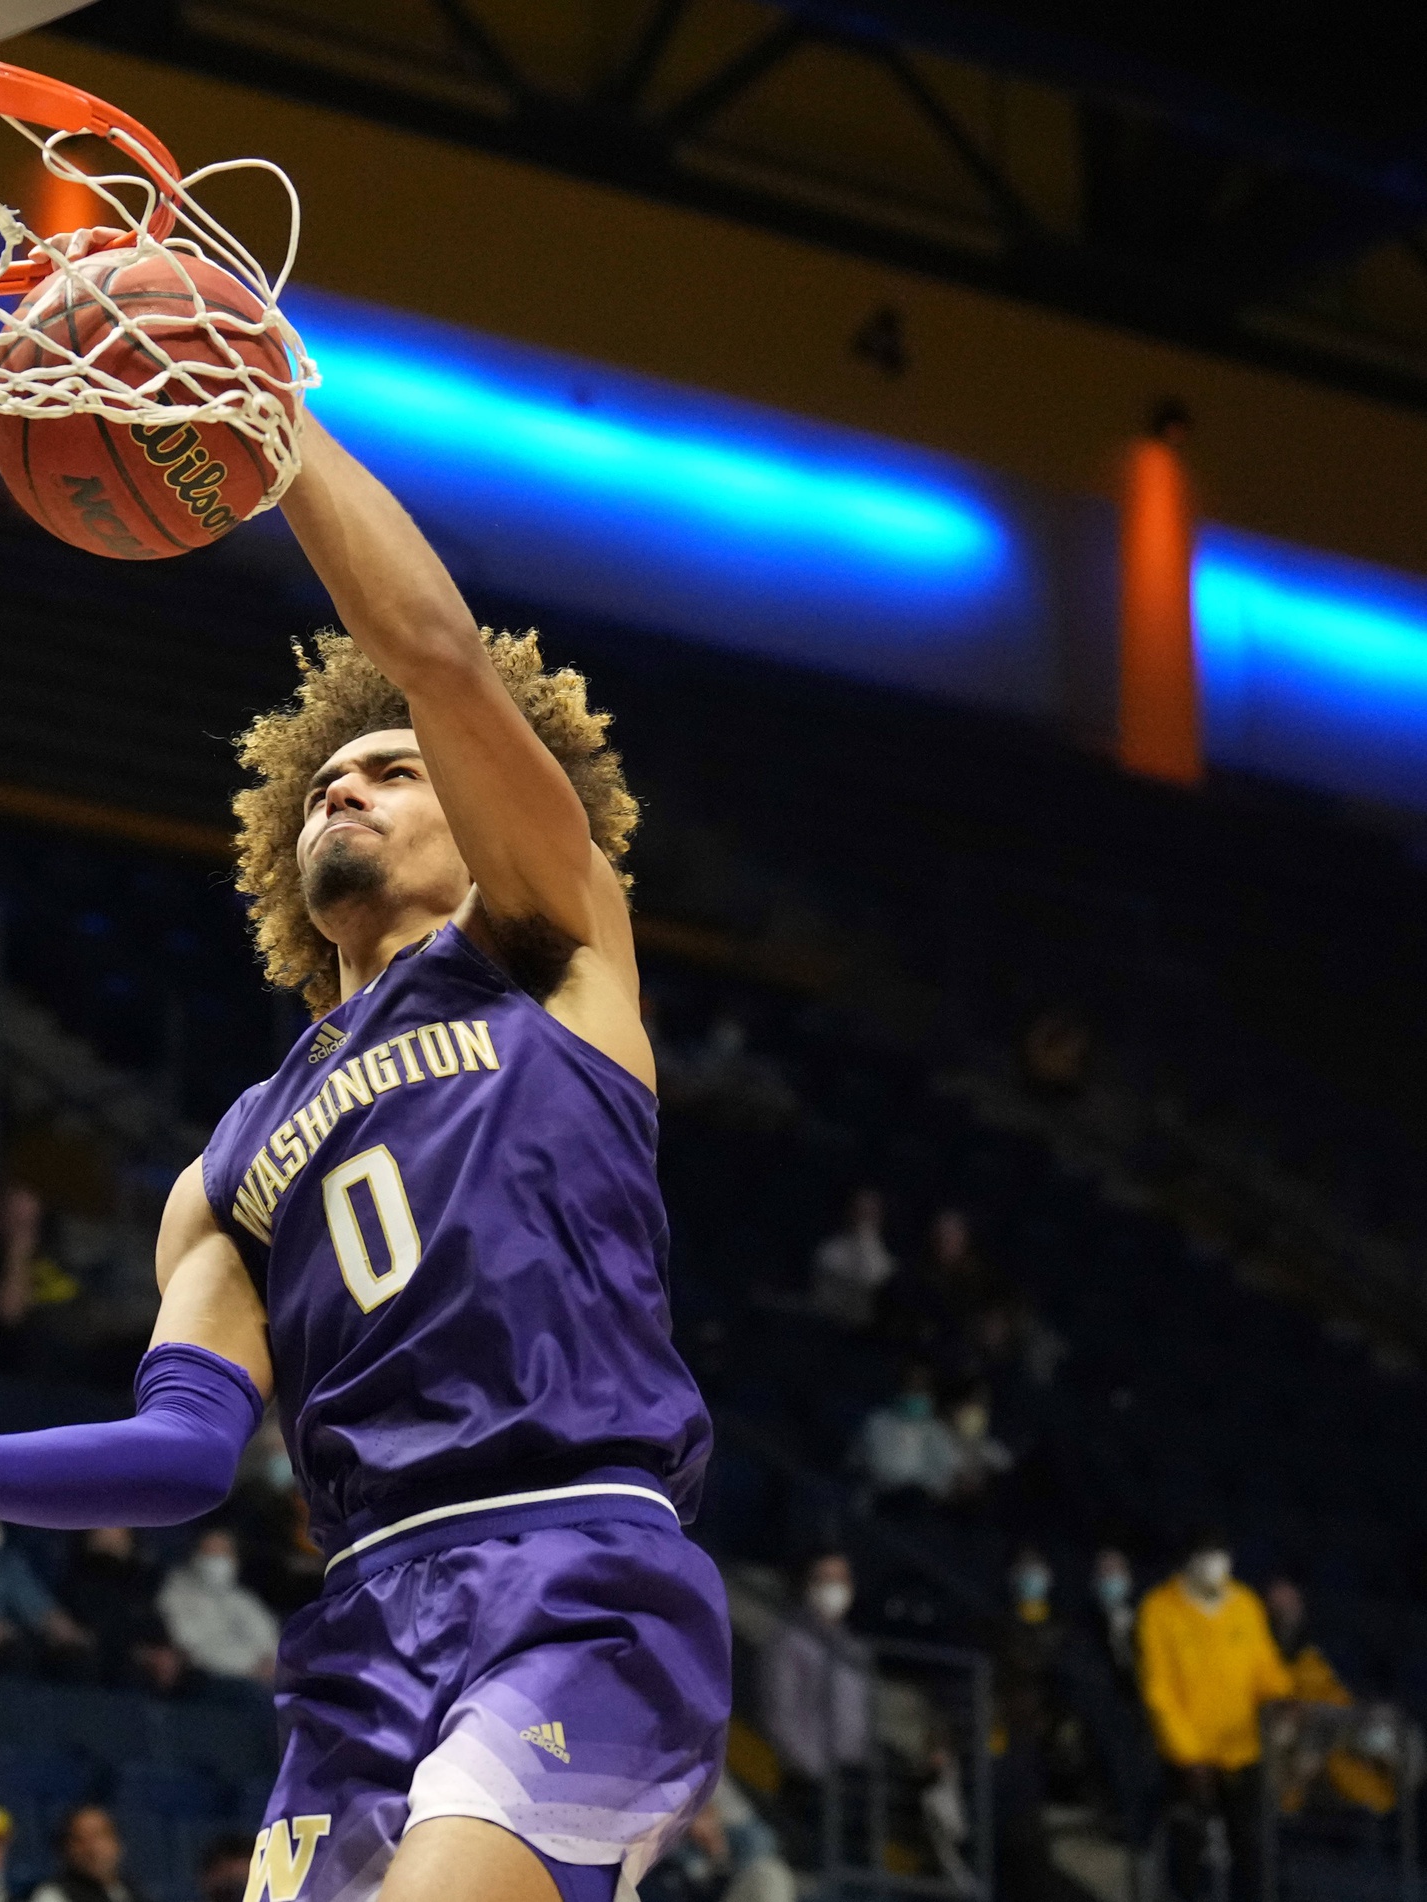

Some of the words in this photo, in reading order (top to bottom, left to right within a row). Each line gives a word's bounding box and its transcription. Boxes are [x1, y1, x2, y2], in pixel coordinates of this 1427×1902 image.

[232, 1020, 500, 1247] WASHINGTON
[322, 1143, 421, 1315] 0
[519, 1729, 571, 1764] adidas
[241, 1813, 332, 1902] W
